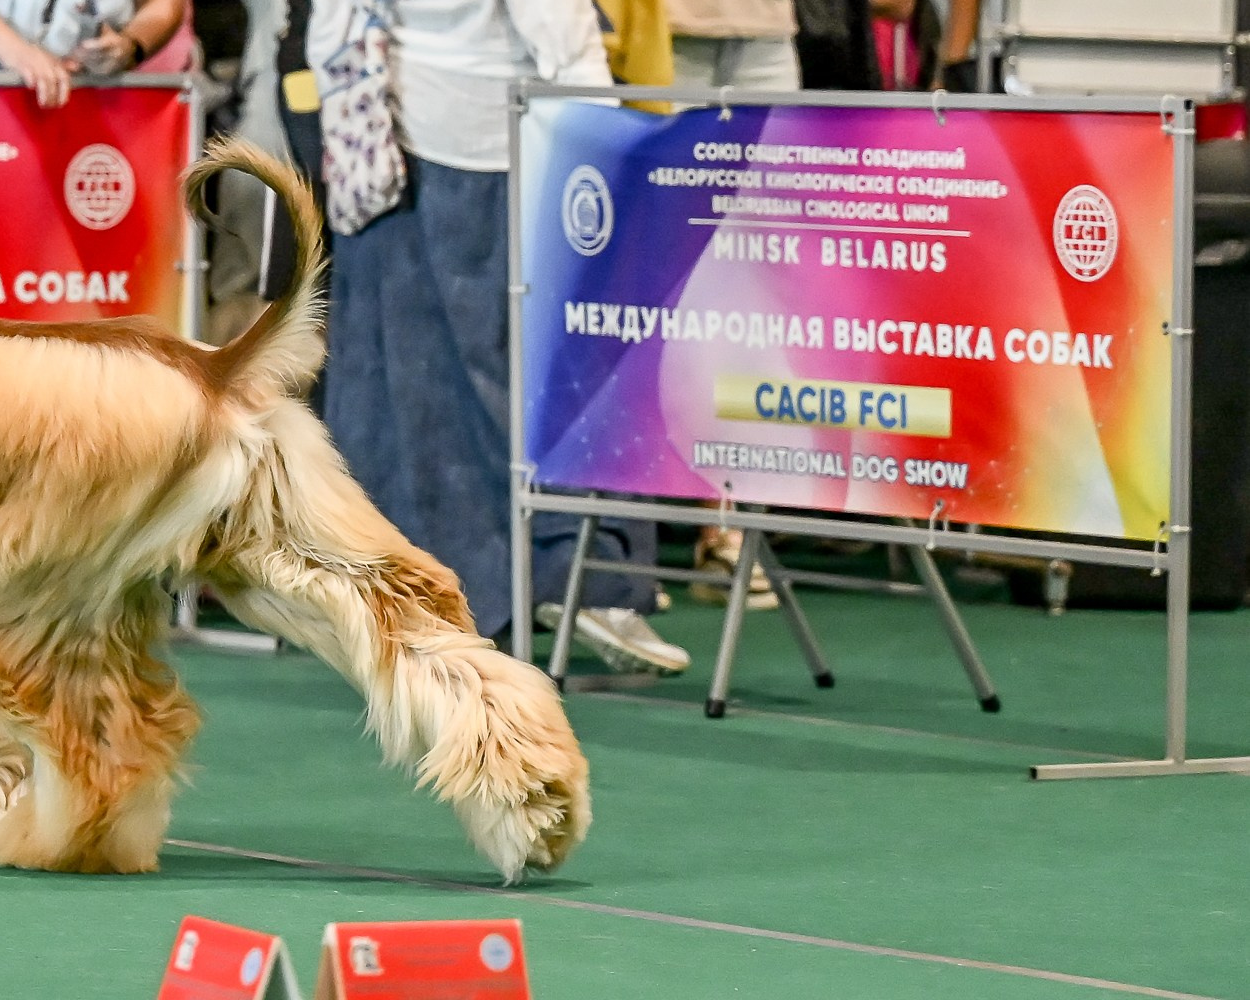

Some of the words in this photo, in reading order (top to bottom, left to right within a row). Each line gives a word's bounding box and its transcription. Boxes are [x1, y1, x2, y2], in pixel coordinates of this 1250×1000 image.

[713, 232, 800, 265] MINSK
[820, 236, 947, 273] BELARUS
[14, 270, 130, 305] СОБАК
[564, 301, 825, 350] МЕЖДУНАРОДНАЯ
[833, 317, 996, 361] ВЫСТАВКА
[1004, 328, 1114, 369] СОБАК
[755, 383, 848, 424] CACIB
[859, 390, 908, 429] FCI
[693, 440, 847, 478] INTERNATIONAL
[852, 454, 899, 483] DOG
[903, 457, 969, 490] SHOW
